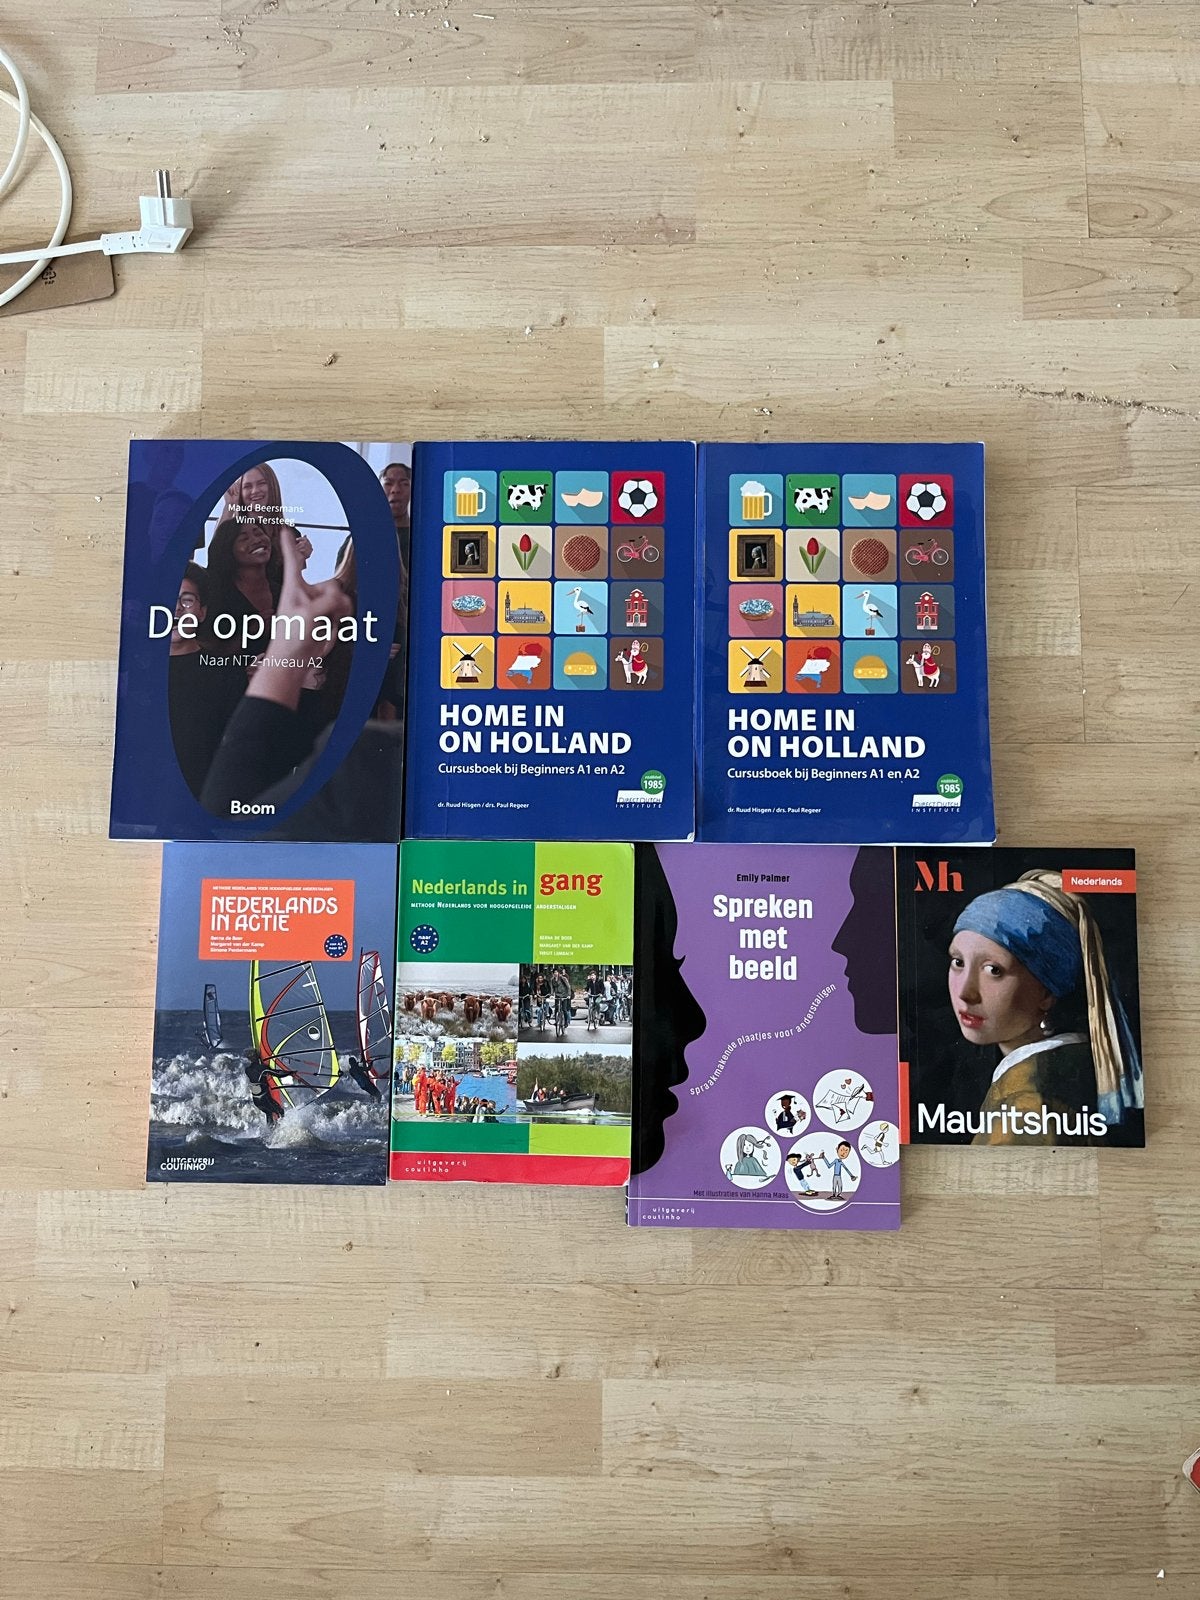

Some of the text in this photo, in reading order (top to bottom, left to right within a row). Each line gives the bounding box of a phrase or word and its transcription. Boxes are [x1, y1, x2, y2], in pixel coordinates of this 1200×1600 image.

[228, 503, 304, 513] Maud Beersmans
[235, 515, 295, 527] Wim Tersteeg
[148, 605, 378, 648] De opmaat
[199, 654, 323, 669] Naar NT2-niveau A2
[440, 704, 564, 727] HOME IN
[728, 709, 855, 731] HOME IN
[439, 731, 632, 755] ON HOLLAND
[727, 735, 926, 758] ON HOLLAND
[438, 762, 625, 777] Cursusboek bij Beginners A1 en A2
[727, 768, 920, 781] Cursusboek bij Beginners A1 en A2
[643, 780, 663, 789] 1985
[940, 784, 961, 793] 1985
[230, 800, 275, 815] Boom
[412, 873, 603, 896] Nederlands in gang
[736, 873, 790, 884] Emily Palmer
[914, 861, 965, 892] Mh
[1071, 876, 1123, 886] Nederlands
[212, 896, 338, 915] NEDERLANDS
[713, 894, 813, 922] Spreken
[211, 914, 289, 932] IN ACTIE
[739, 926, 788, 949] met
[730, 955, 797, 980] beeld
[690, 983, 837, 1096] spraakmakende plaatjes voor anderstaligen
[918, 1103, 1108, 1136] Mauritshuis
[167, 1157, 214, 1165] UITGEVERIJ
[706, 1190, 738, 1198] illustraties
[752, 1191, 772, 1199] Hanna
[652, 1207, 695, 1215] uitgeverij
